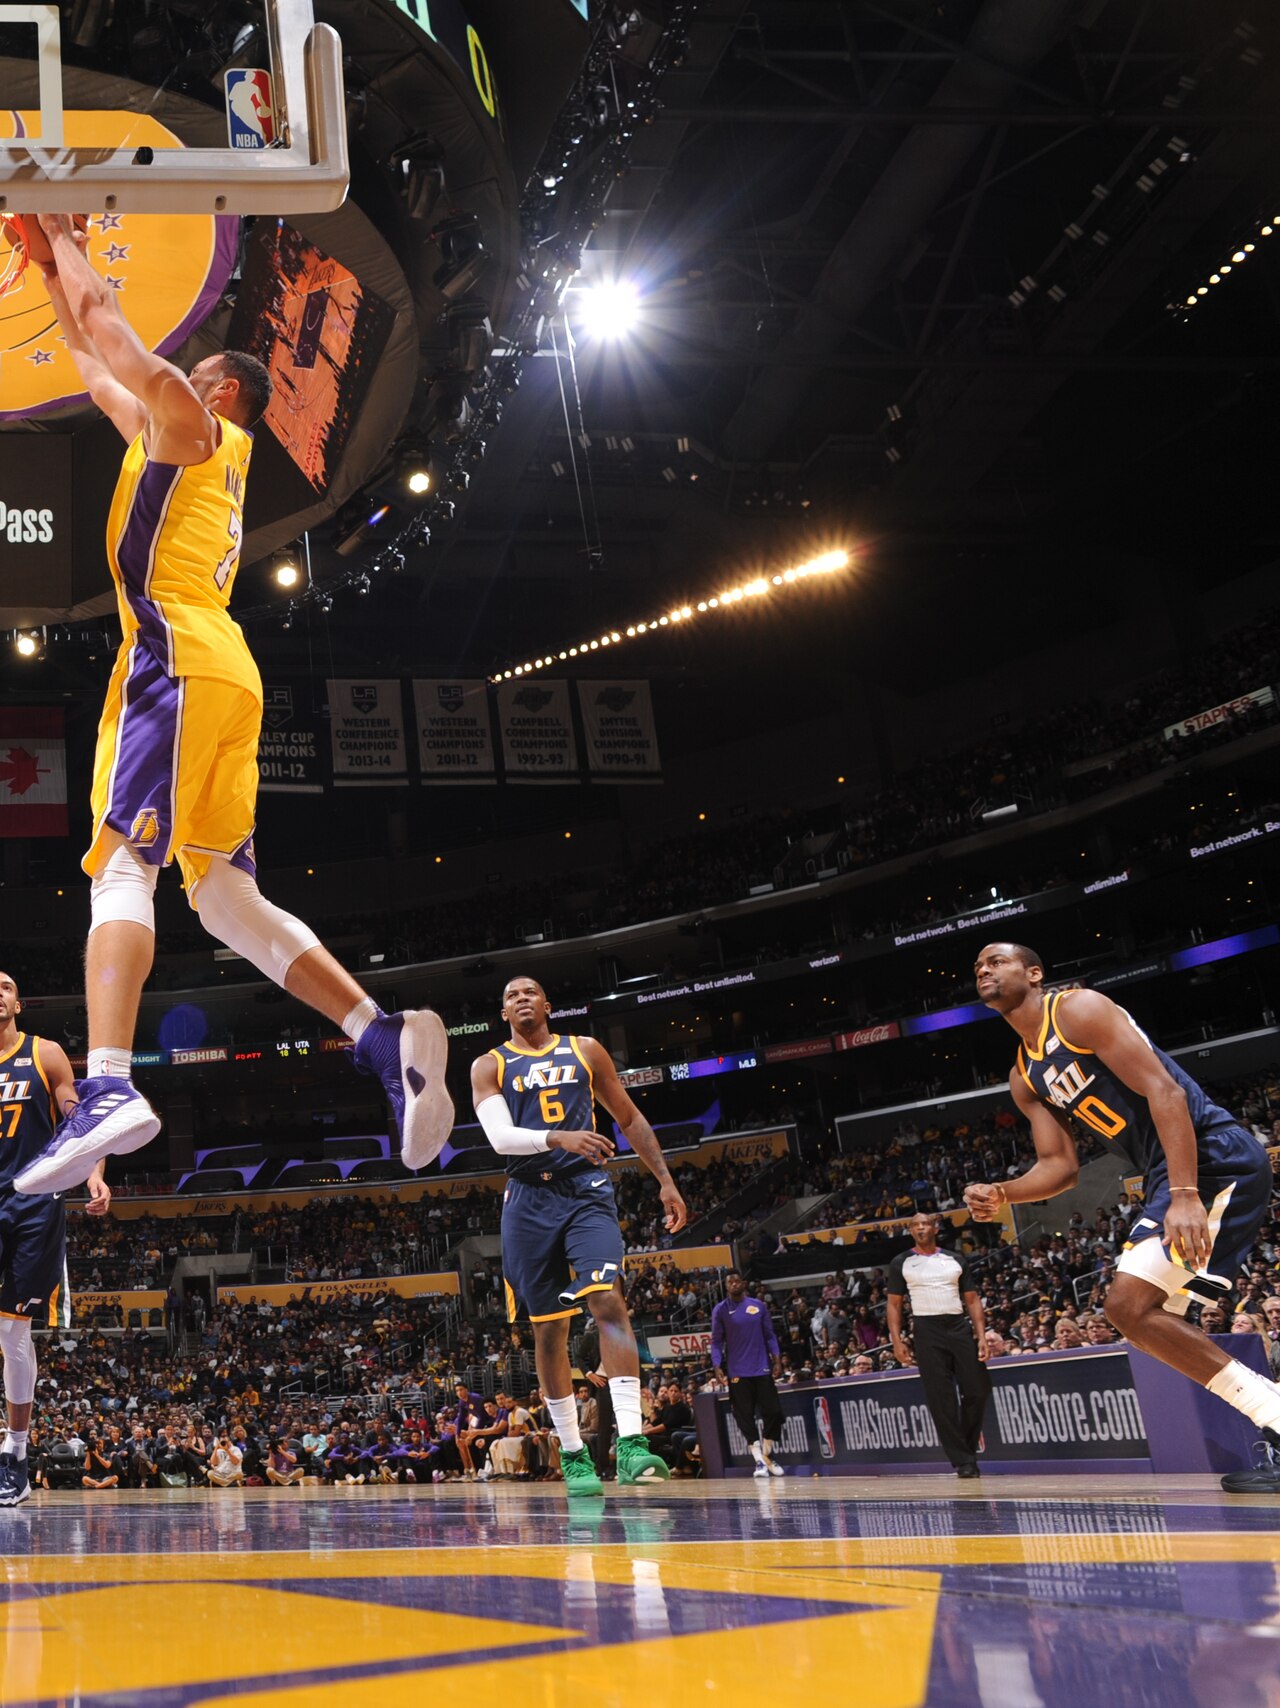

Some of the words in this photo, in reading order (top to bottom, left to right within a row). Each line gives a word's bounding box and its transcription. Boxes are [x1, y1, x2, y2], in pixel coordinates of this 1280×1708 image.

[236, 134, 258, 148] NBA
[343, 718, 390, 728] WESTERN
[429, 717, 477, 727] WESTERN
[291, 732, 315, 744] CUP
[335, 729, 400, 739] CONFERENCE
[423, 728, 487, 738] CONFERENCE
[340, 741, 398, 751] CHAMPIONS
[427, 740, 485, 750] CHAMPIONS
[347, 755, 391, 767] 2013-14
[437, 754, 478, 766] 2011-12
[261, 763, 306, 779] 011-12
[1190, 843, 1215, 859] Best
[1215, 829, 1263, 850] network.
[1265, 820, 1280, 833] Be
[1084, 874, 1128, 891] unlimited
[894, 934, 915, 947] Best
[915, 923, 956, 941] network.
[957, 917, 980, 931] Best
[980, 903, 1028, 924] unlimited.
[809, 956, 840, 968] verizon
[637, 992, 658, 1004] Best
[657, 984, 692, 1001] network.
[694, 980, 714, 992] Best
[713, 972, 756, 988] unlimited.
[549, 1006, 588, 1020] unlimited
[447, 1021, 489, 1037] verizon
[276, 1042, 290, 1051] LAL
[295, 1040, 310, 1049] UTA
[139, 1055, 160, 1064] LIGHT
[173, 1050, 227, 1063] TOSHIBA
[280, 1049, 289, 1058] 18
[298, 1048, 308, 1056] 14
[670, 1063, 689, 1073] WAS
[671, 1070, 690, 1081] CHC
[738, 1058, 757, 1070] MLB
[523, 1060, 579, 1090] JAZZ
[1043, 1061, 1096, 1109] JAZZ
[539, 1088, 565, 1124] 6
[1072, 1095, 1127, 1140] 10
[340, 1280, 388, 1290] ANGELES
[670, 1334, 712, 1355] STAP
[993, 1382, 1147, 1446] NBAStore.com
[840, 1398, 939, 1451] NBAStore.co
